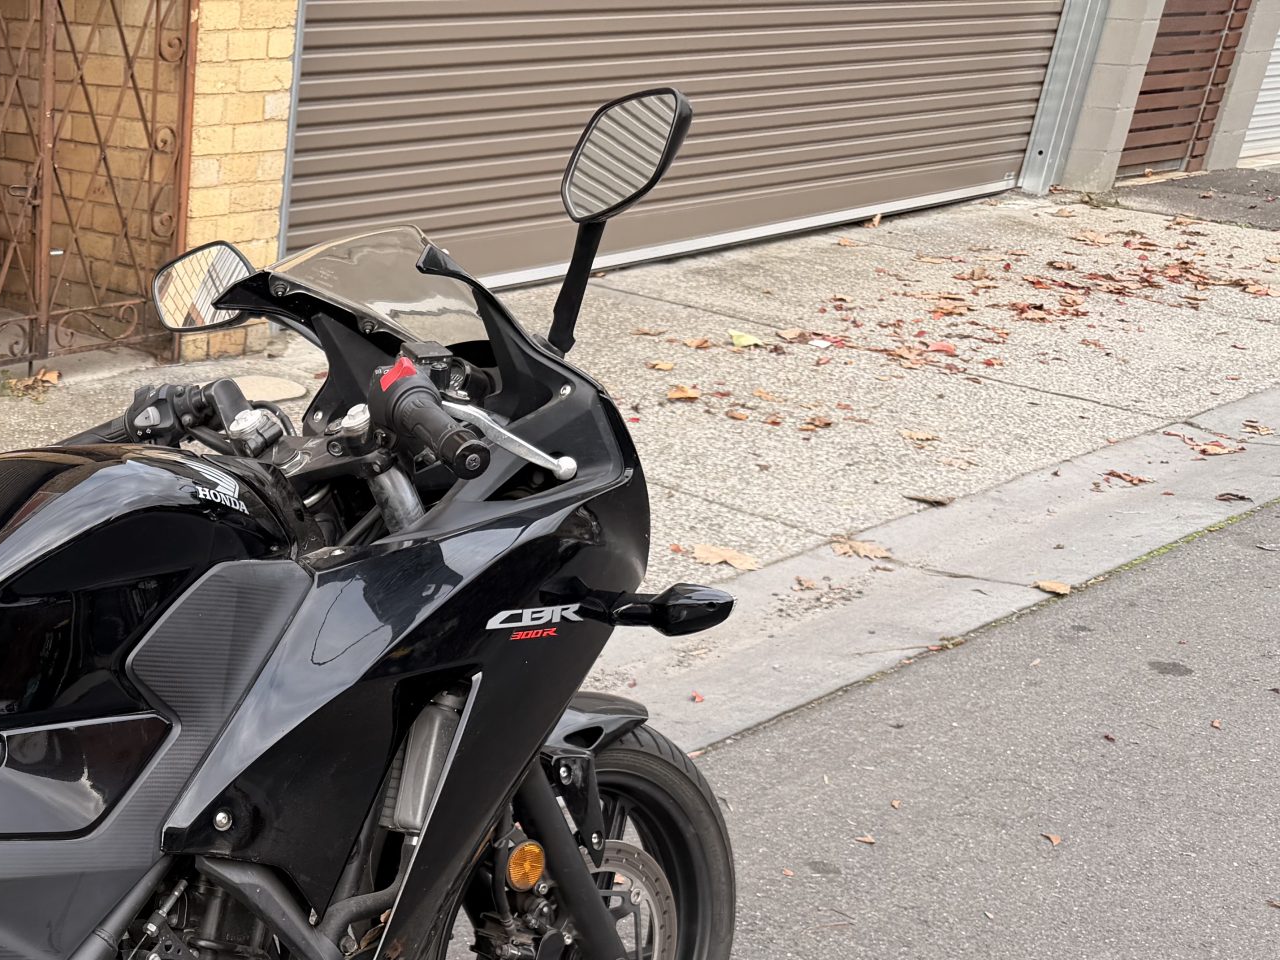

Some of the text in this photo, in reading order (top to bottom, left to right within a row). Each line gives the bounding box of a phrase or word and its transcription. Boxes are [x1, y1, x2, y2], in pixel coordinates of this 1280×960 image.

[196, 487, 250, 515] HONDA
[485, 603, 584, 630] CBR
[510, 627, 558, 640] 300R
